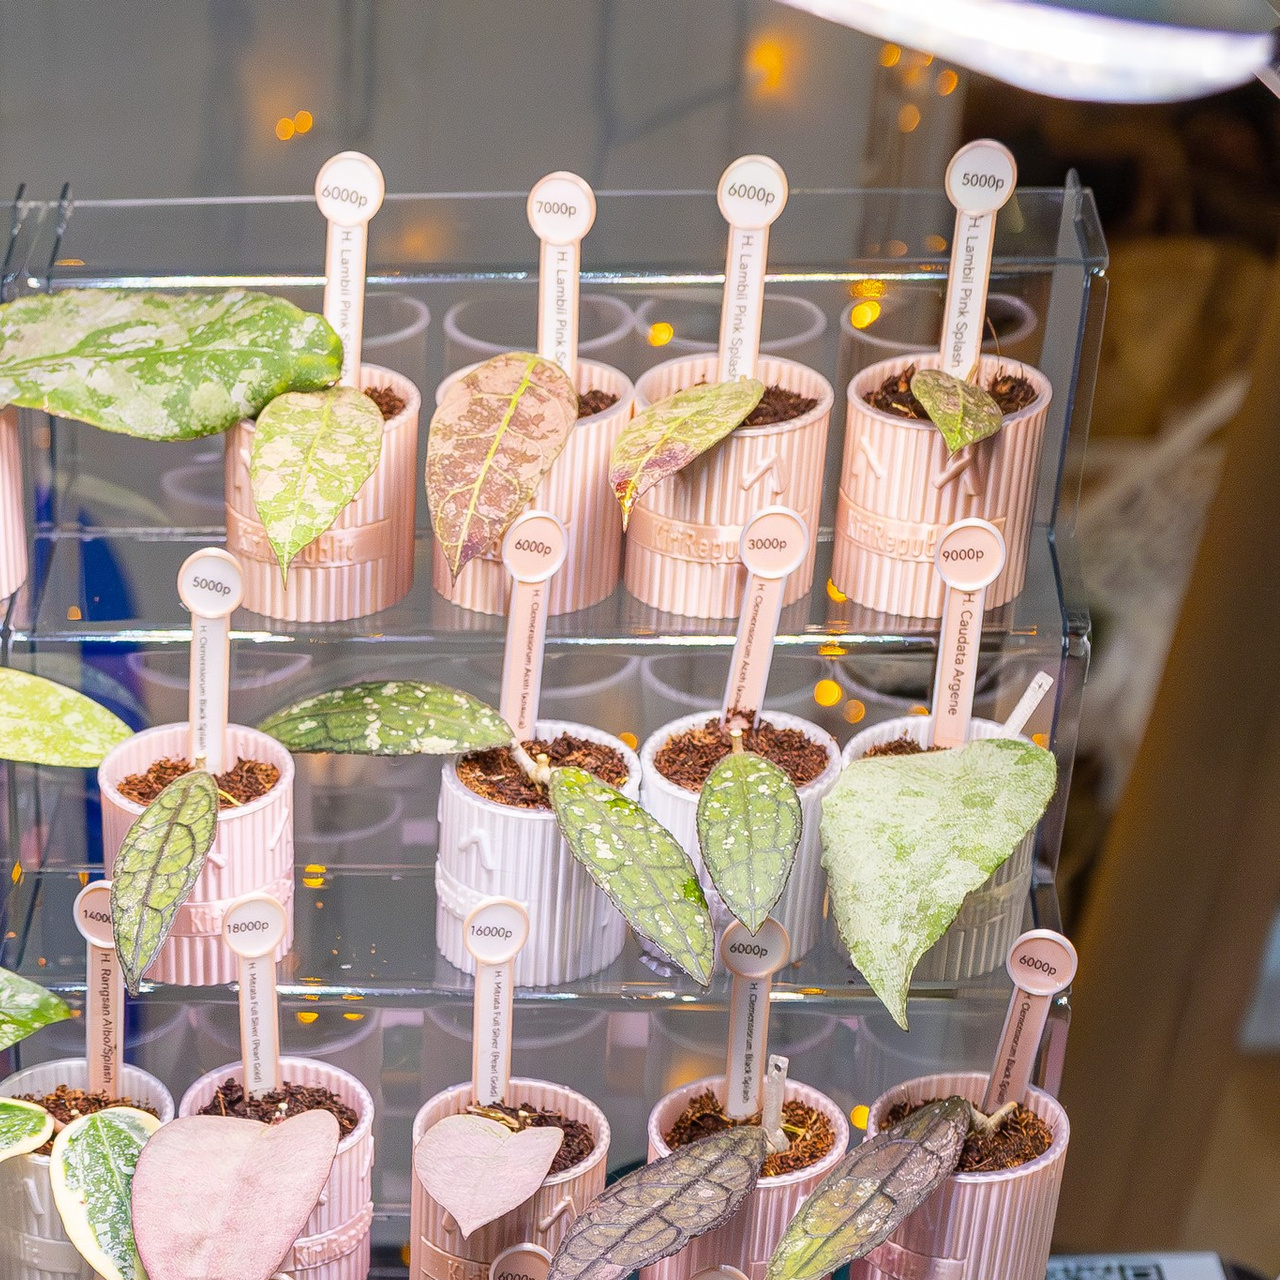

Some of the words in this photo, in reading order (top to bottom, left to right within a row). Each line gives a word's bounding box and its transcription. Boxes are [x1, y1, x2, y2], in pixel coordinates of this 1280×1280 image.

[961, 172, 1005, 192] 5000p
[321, 184, 368, 209] 6000p
[727, 182, 776, 207] 6000p
[535, 200, 577, 219] 7000p
[956, 287, 972, 318] Pink
[338, 299, 351, 330] Pink
[731, 303, 746, 335] Pink
[555, 318, 567, 348] Pink
[949, 320, 968, 369] Splash
[724, 336, 743, 383] Splash
[514, 538, 552, 557] 6000p
[747, 537, 787, 554] 3000p
[942, 548, 984, 564] 9000p
[191, 575, 231, 597] 5000p
[953, 608, 974, 666] Caudata
[944, 667, 965, 717] Argene
[198, 697, 207, 719] Black
[226, 920, 269, 935] 18000p
[470, 924, 513, 940] 16000p
[729, 943, 768, 958] 6000p
[1019, 954, 1057, 976] 6000p
[97, 967, 112, 1016] Rangsan
